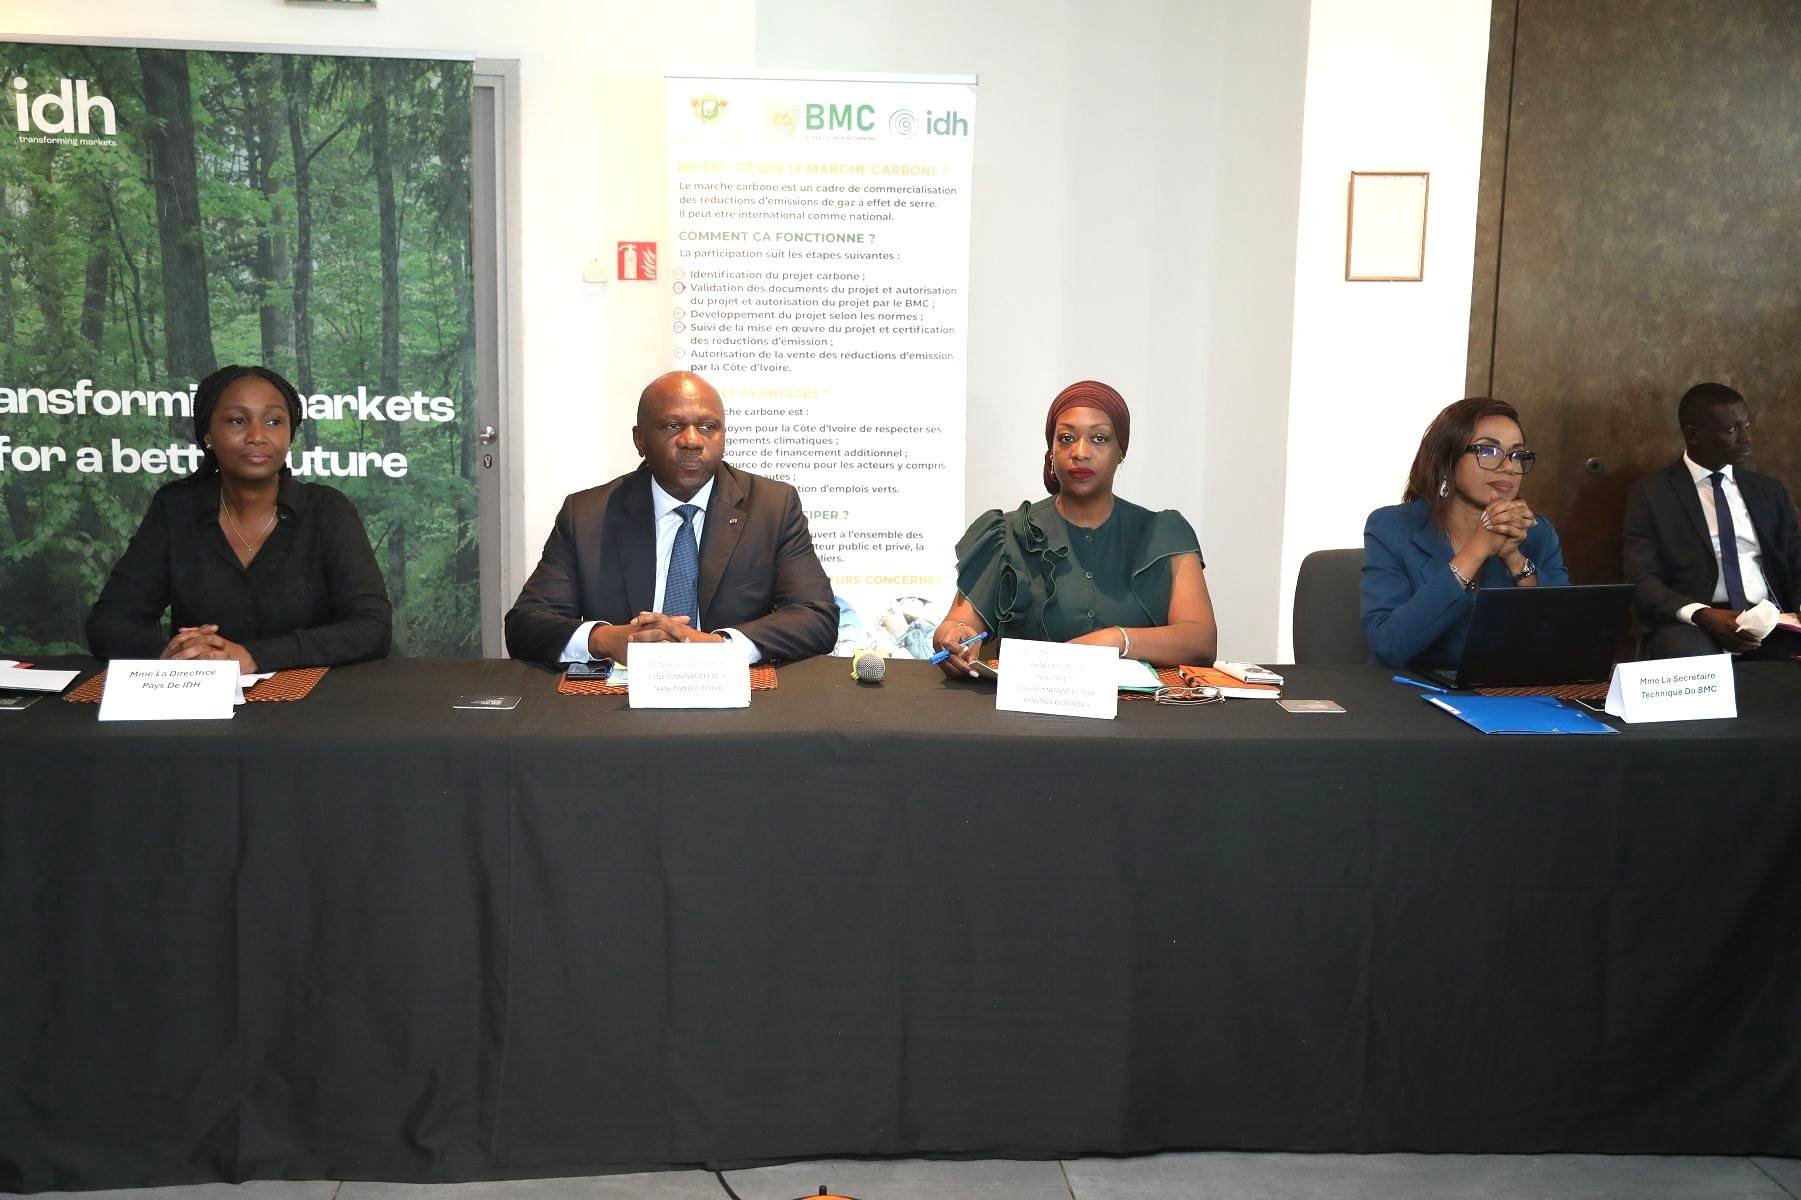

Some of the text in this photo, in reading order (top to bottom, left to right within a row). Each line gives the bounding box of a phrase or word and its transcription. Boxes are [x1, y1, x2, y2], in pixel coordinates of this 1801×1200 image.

[13, 76, 117, 135] idh
[805, 103, 876, 131] BMC
[926, 109, 969, 137] idh
[19, 136, 118, 147] transforming markets
[680, 182, 691, 190] Le
[737, 182, 779, 191] carbone
[781, 184, 797, 192] est
[800, 184, 813, 192] un
[816, 184, 845, 192] cadre
[848, 184, 861, 193] de
[863, 185, 957, 195] commercialisation
[680, 196, 697, 204] des
[821, 198, 835, 206] de
[837, 199, 855, 208] gaz
[867, 198, 891, 207] effet
[893, 199, 907, 207] de
[909, 200, 937, 208] serre.
[688, 210, 712, 219] peut
[738, 210, 805, 220] international
[849, 212, 894, 221] national.
[679, 231, 876, 244] COMMENT ÇA FONCTIONNE ?
[680, 249, 691, 257] La
[694, 249, 763, 259] participation
[765, 250, 785, 258] suit
[788, 250, 803, 259] les
[844, 251, 895, 260] suivantes
[690, 269, 762, 279] Identification
[765, 270, 779, 279] du
[782, 270, 814, 281] projet
[817, 272, 860, 280] carbone
[690, 283, 744, 292] Validation
[747, 283, 766, 293] des
[768, 284, 828, 293] documents
[831, 285, 845, 294] du
[848, 285, 879, 295] projet
[882, 286, 893, 294] et
[896, 286, 957, 295] autorisation
[690, 297, 704, 305] du
[707, 297, 739, 307] projet
[756, 297, 819, 306] autorisation
[822, 299, 836, 307] du
[838, 298, 870, 308] projet
[873, 300, 890, 308] par
[893, 299, 903, 307] le
[905, 299, 929, 308] BMC
[778, 311, 792, 319] du
[795, 311, 826, 321] projet
[829, 312, 857, 320] selon
[860, 312, 875, 320] les
[878, 313, 918, 321] normes
[690, 323, 716, 332] Suivi
[718, 323, 732, 332] de
[735, 324, 744, 332] la
[747, 323, 772, 332] mise
[828, 325, 842, 333] du
[845, 324, 876, 335] projet
[879, 325, 890, 333] et
[892, 324, 955, 334] certification
[690, 336, 709, 345] des
[690, 349, 756, 358] Autorisation
[758, 350, 772, 359] de
[774, 350, 784, 359] la
[786, 351, 816, 359] vente
[819, 350, 838, 359] des
[690, 363, 708, 372] par
[710, 363, 720, 372] la
[750, 363, 792, 372] d'Ivoire.
[0, 379, 456, 422] ansformi arkets
[744, 407, 786, 416] carbone
[726, 425, 752, 434] oyen
[755, 425, 779, 434] pour
[781, 424, 790, 433] la
[819, 424, 857, 433] d'Ivoire
[859, 424, 873, 433] de
[875, 426, 923, 435] respecter
[925, 426, 942, 434] ses
[725, 436, 833, 446] gements climatiques
[76, 446, 103, 473] a
[111, 438, 204, 475] bett
[286, 446, 408, 478] uture
[760, 449, 773, 457] de
[776, 448, 841, 457] financement
[844, 449, 903, 458] additionnel
[760, 461, 773, 469] de
[813, 462, 837, 470] pour
[840, 460, 854, 469] les
[857, 461, 895, 470] acteurs
[897, 463, 903, 471] y
[905, 461, 946, 471] compris
[820, 484, 869, 494] d'emplois
[811, 531, 837, 539] uvert
[848, 530, 904, 539] l'ensemble
[906, 531, 924, 539] des
[838, 542, 870, 552] public
[872, 543, 883, 551] et
[916, 542, 925, 551] la
[169, 669, 217, 677] Directrice
[142, 681, 201, 690] Pays De IDH
[1640, 677, 1660, 685] Mme
[1662, 676, 1672, 684] La
[1641, 685, 1717, 699] Technique Du BMC
